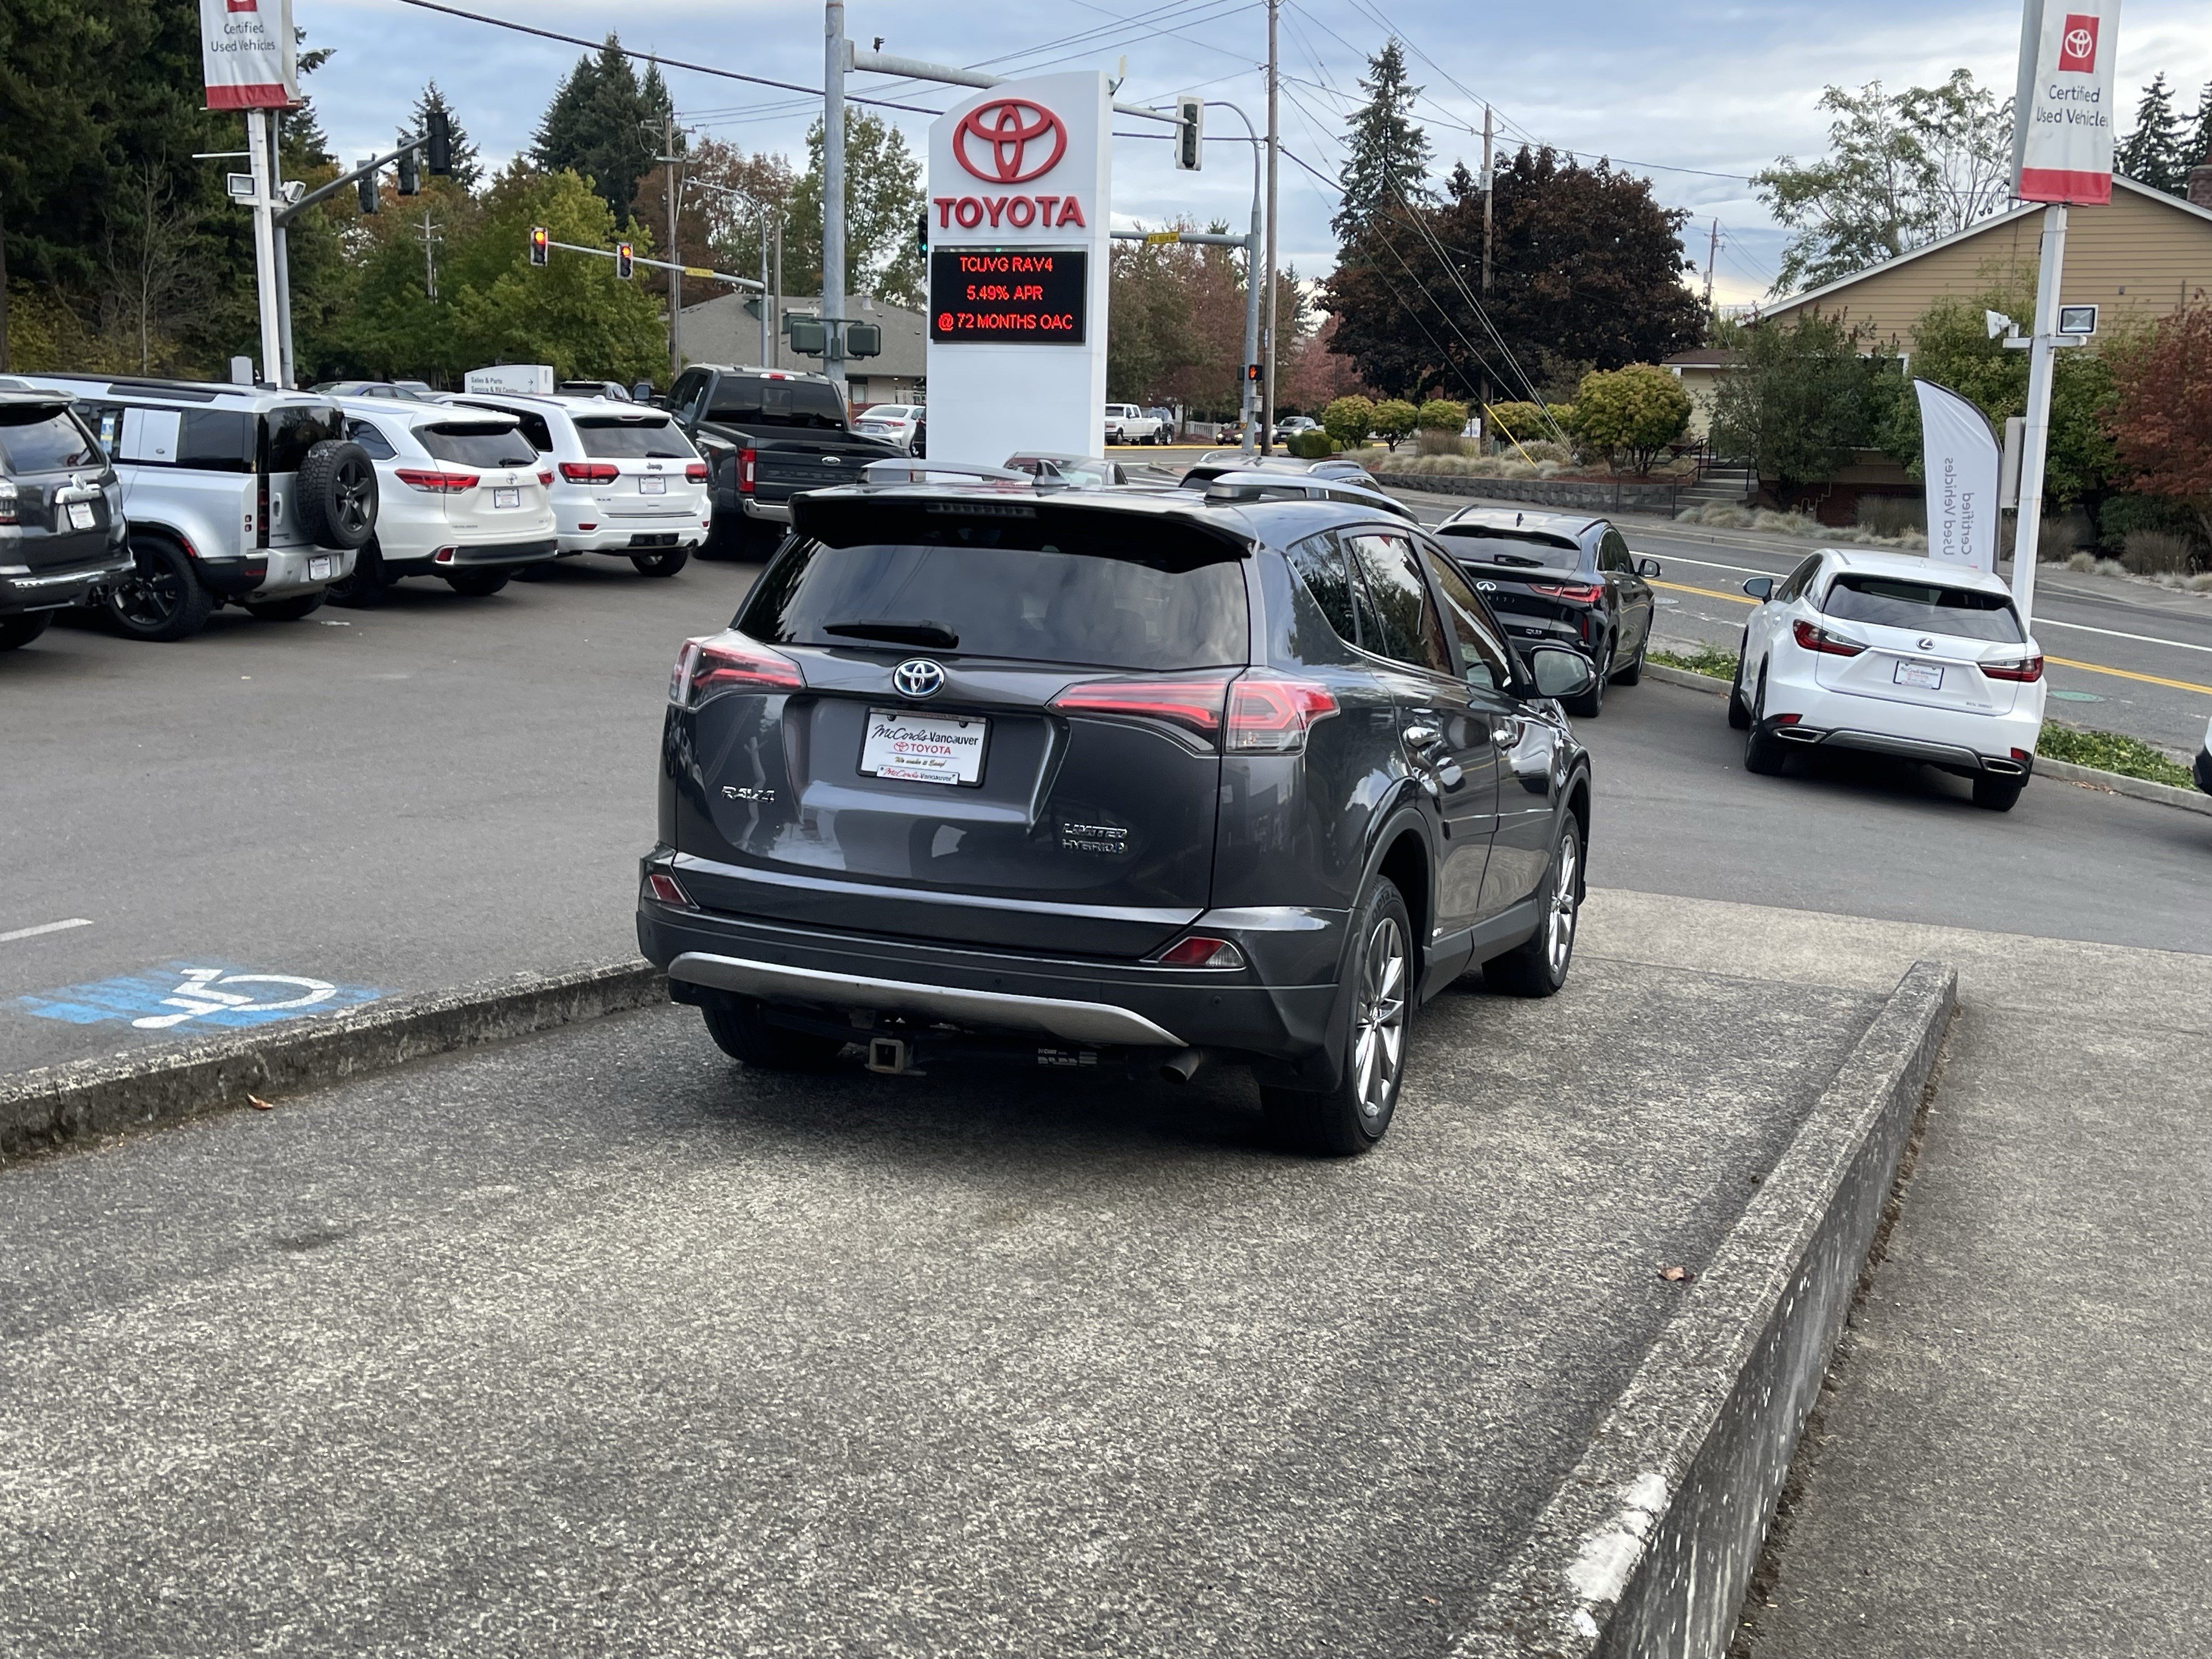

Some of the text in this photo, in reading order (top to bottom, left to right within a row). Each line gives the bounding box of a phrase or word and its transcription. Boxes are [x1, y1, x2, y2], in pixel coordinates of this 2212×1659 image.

[224, 21, 264, 35] Certified
[211, 38, 275, 52] Used Vehicles
[2049, 84, 2101, 103] Certified
[2036, 106, 2063, 123] Used
[933, 196, 1086, 228] TOYOTA
[1012, 256, 1054, 272] RAV4
[967, 285, 1043, 301] 5.49% APR
[938, 312, 1073, 331] @ 72 MONTHS OAC
[910, 743, 951, 755] TOYOTA
[721, 786, 775, 804] RAV4
